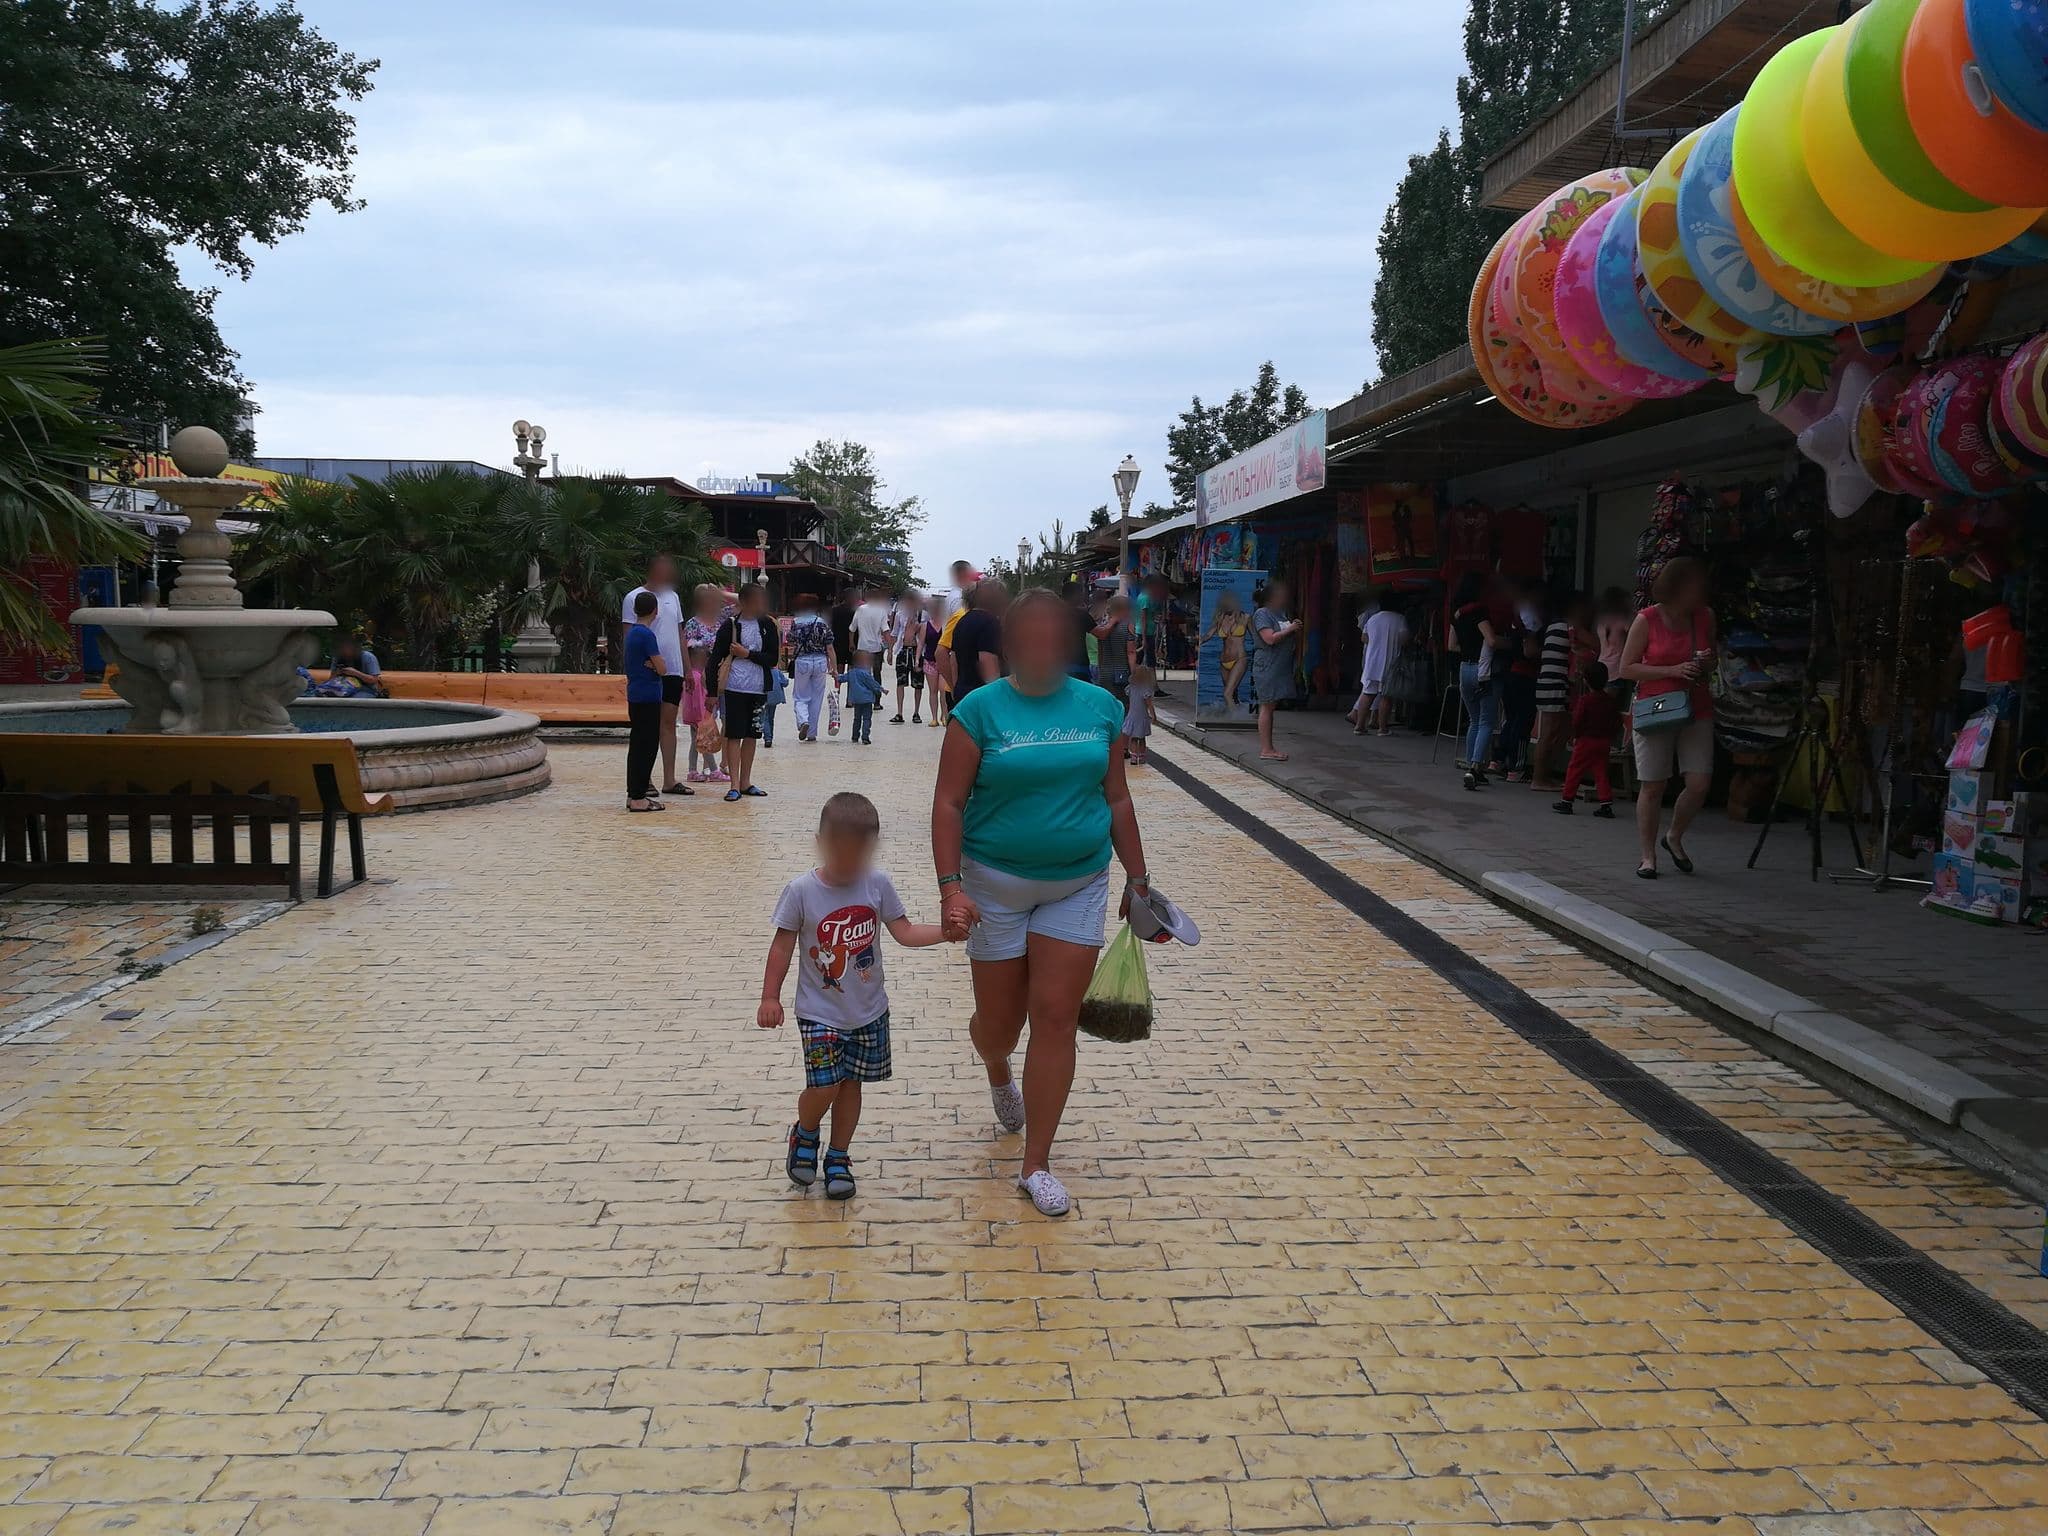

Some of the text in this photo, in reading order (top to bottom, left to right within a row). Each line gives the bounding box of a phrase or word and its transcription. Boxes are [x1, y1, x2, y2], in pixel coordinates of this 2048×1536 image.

[1219, 451, 1276, 506] КУПАЛЬНИКИ
[1041, 727, 1100, 742] Brillante
[821, 914, 876, 947] Team
